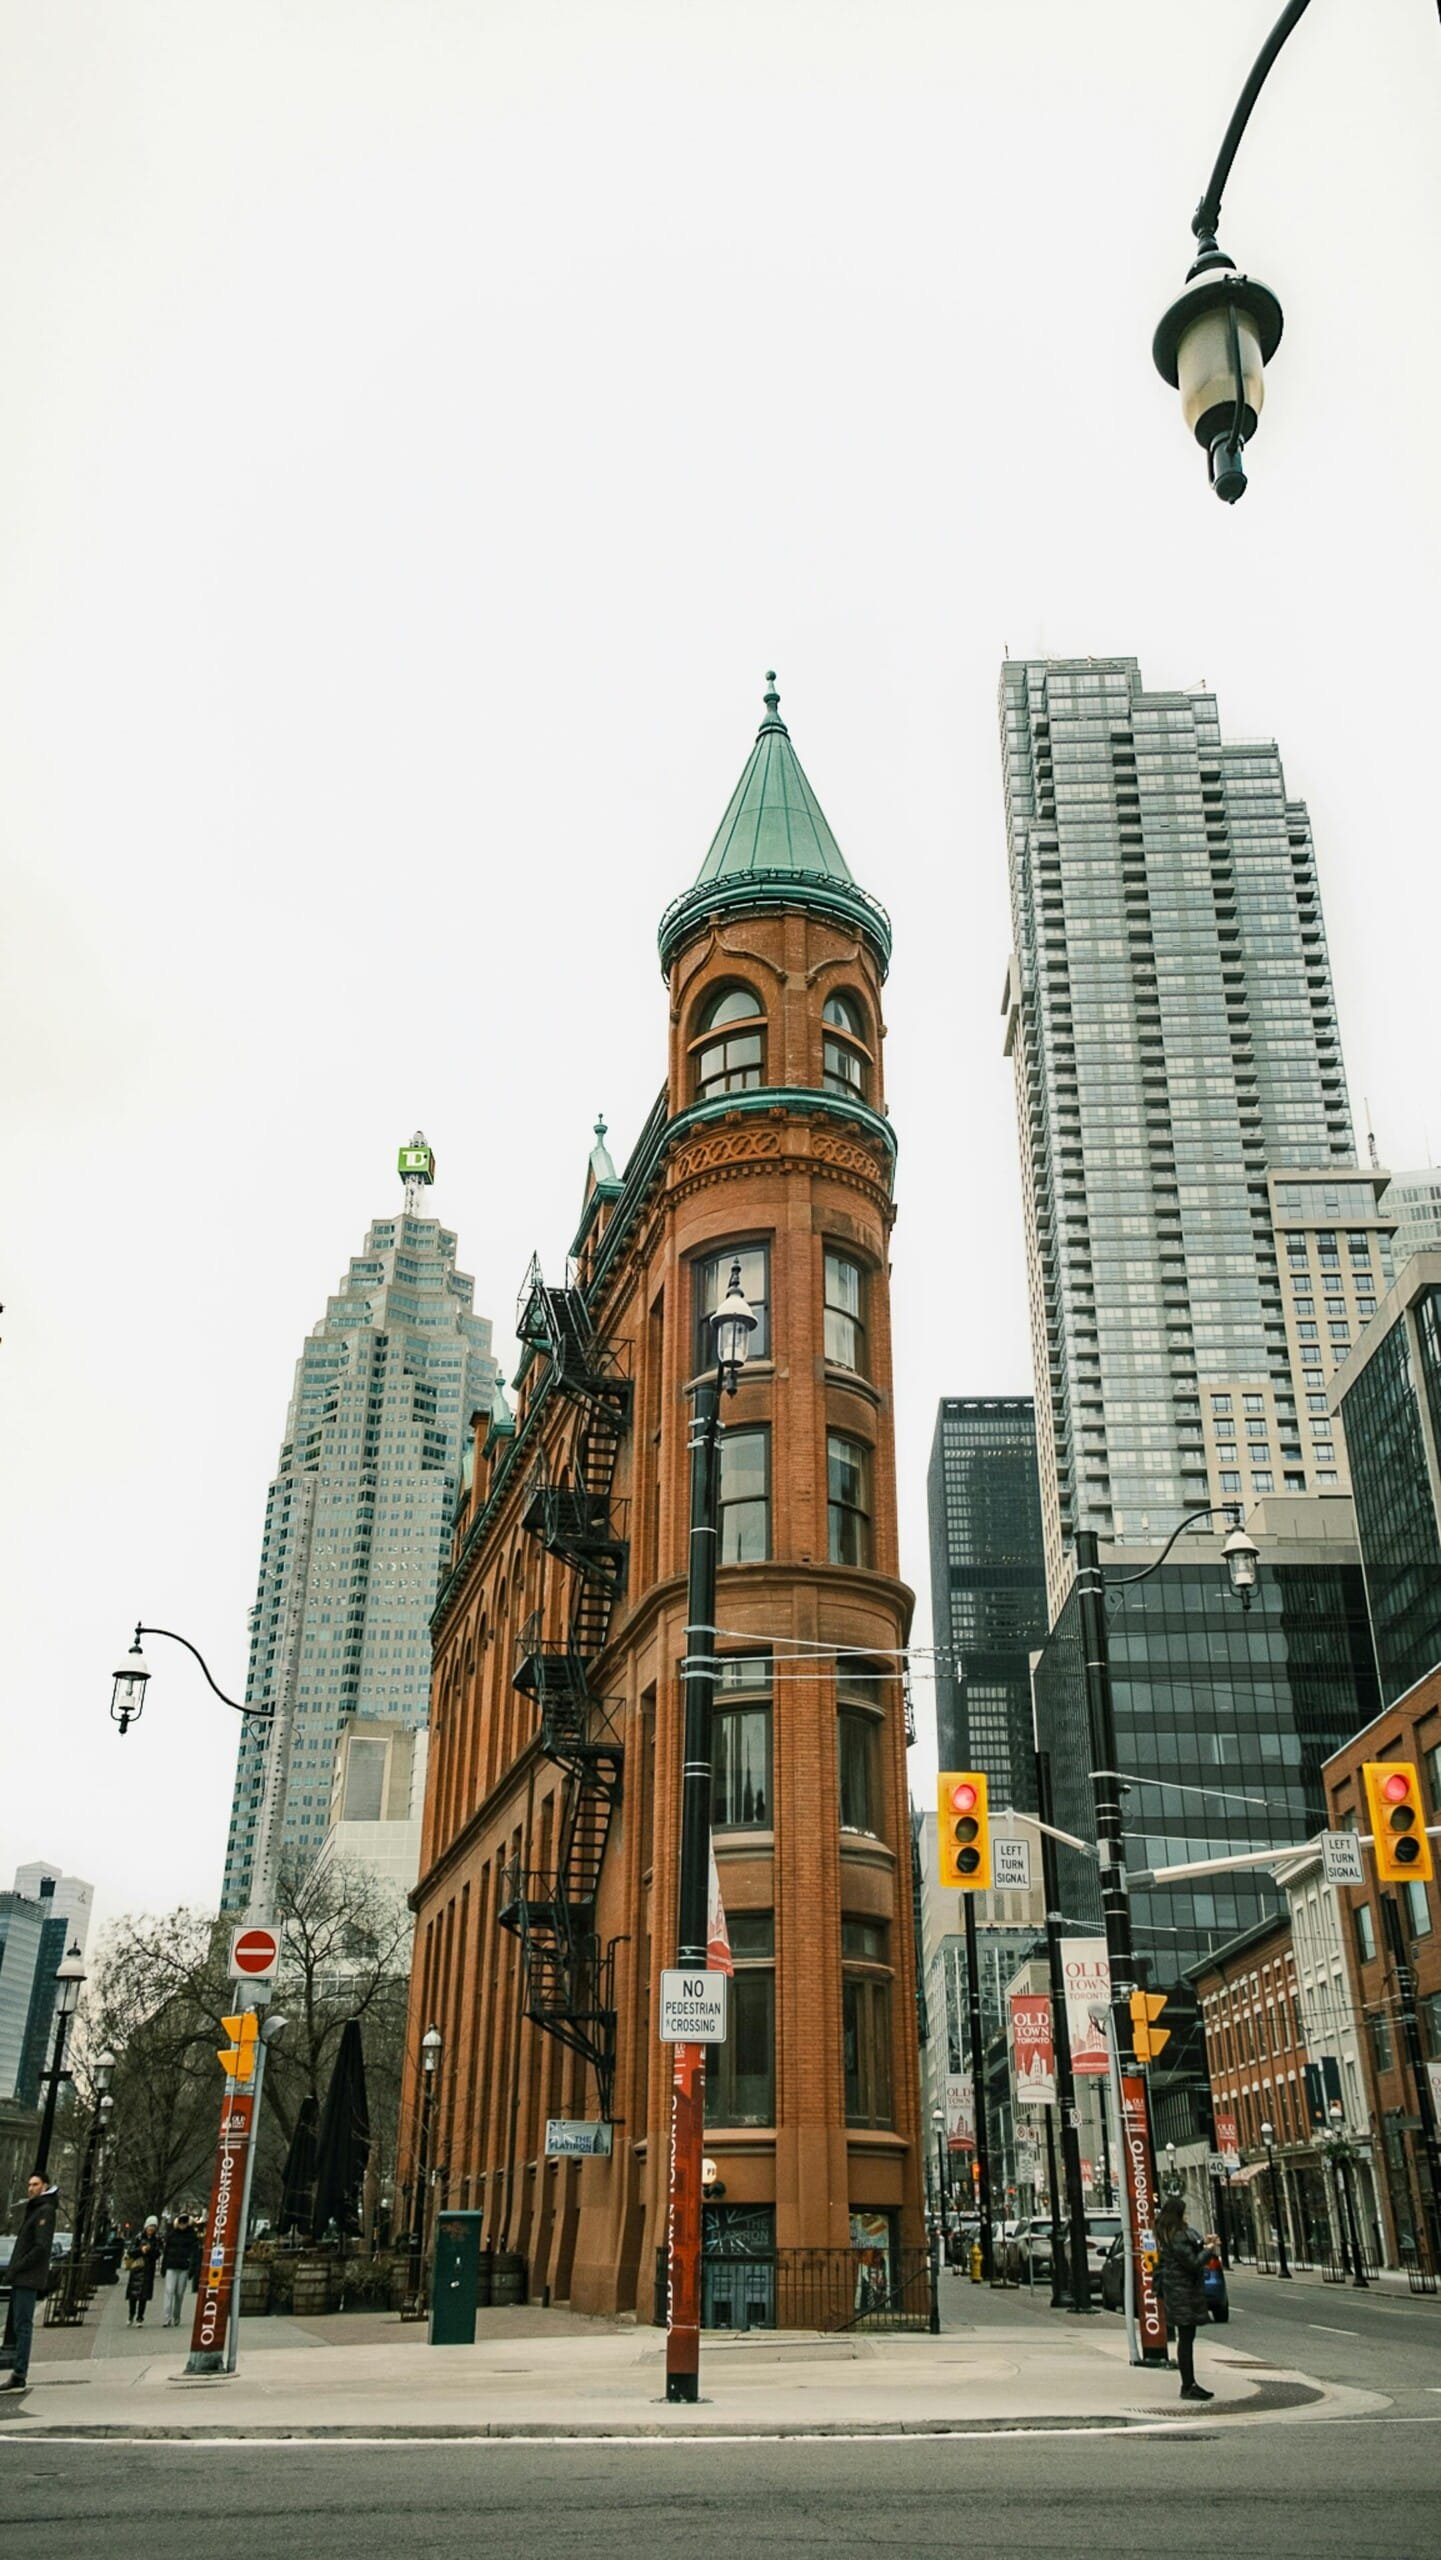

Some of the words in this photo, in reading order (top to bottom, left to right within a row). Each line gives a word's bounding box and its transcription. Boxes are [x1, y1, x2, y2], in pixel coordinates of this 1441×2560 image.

[402, 1151, 427, 1167] TD
[1329, 1840, 1350, 1849] LEFT
[1001, 1845, 1021, 1856] LEFT
[1331, 1853, 1354, 1863] TURN
[1001, 1859, 1023, 1869] TURN
[1328, 1867, 1360, 1877] SIGNAL
[997, 1873, 1027, 1884] SIGNAL
[1066, 1962, 1109, 1977] OLD
[683, 1980, 704, 1998] NO
[1069, 1980, 1110, 1991] TOWN
[1069, 1992, 1110, 2001] TORONTO
[665, 2001, 721, 2015] PEDESTRIAN
[1014, 2012, 1049, 2026] OLD
[671, 2019, 715, 2032] CROSSING
[1015, 2026, 1050, 2037] TOWN
[1016, 2037, 1050, 2045] TORONTO
[947, 2088, 971, 2097] OLD
[1211, 2162, 1223, 2172] 40
[1132, 2140, 1149, 2223] TORONTO
[200, 2301, 218, 2345] OLD
[213, 2157, 234, 2238] TORONTO
[1144, 2289, 1159, 2335] OLD
